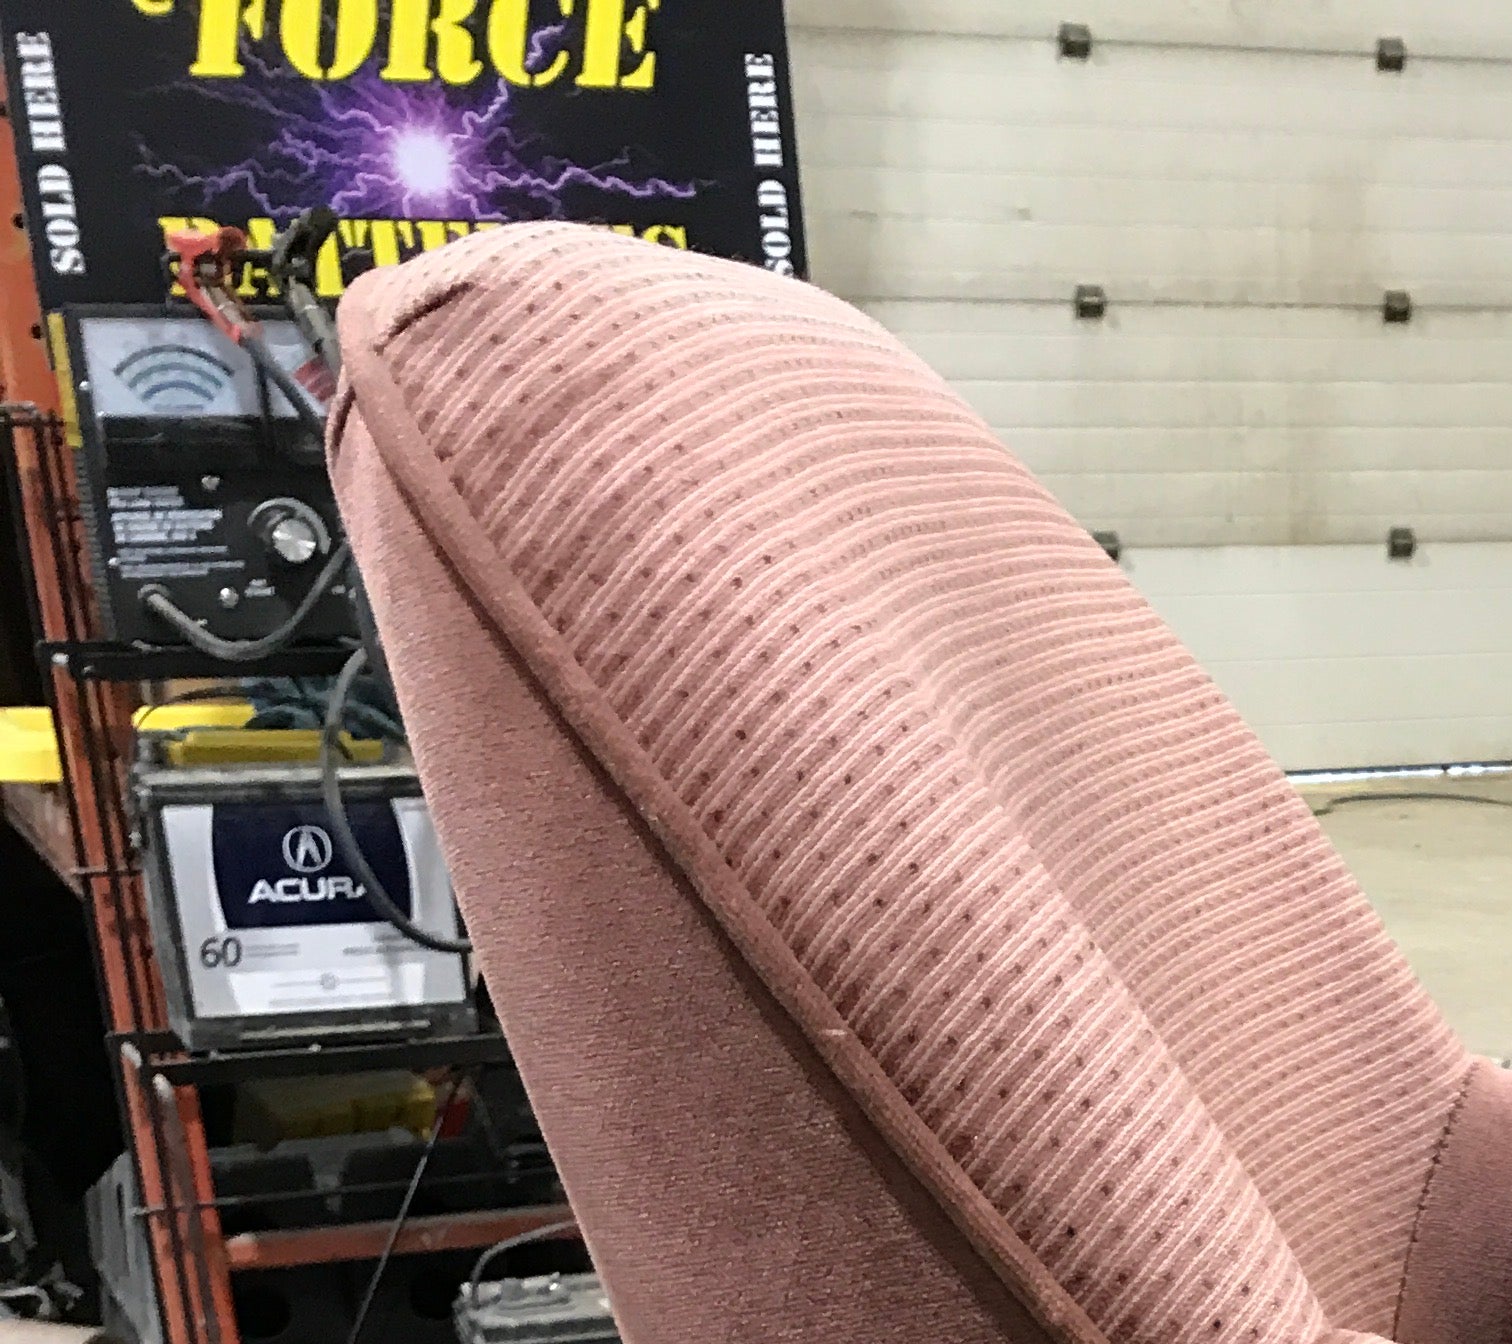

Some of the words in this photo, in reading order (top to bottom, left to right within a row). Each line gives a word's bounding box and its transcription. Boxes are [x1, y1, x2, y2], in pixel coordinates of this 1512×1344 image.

[16, 31, 67, 151] HERE
[189, 0, 660, 88] FORCE
[744, 53, 784, 168] HERE
[37, 163, 87, 275] SOLD
[756, 179, 794, 277] SOLD
[201, 937, 242, 968] 60
